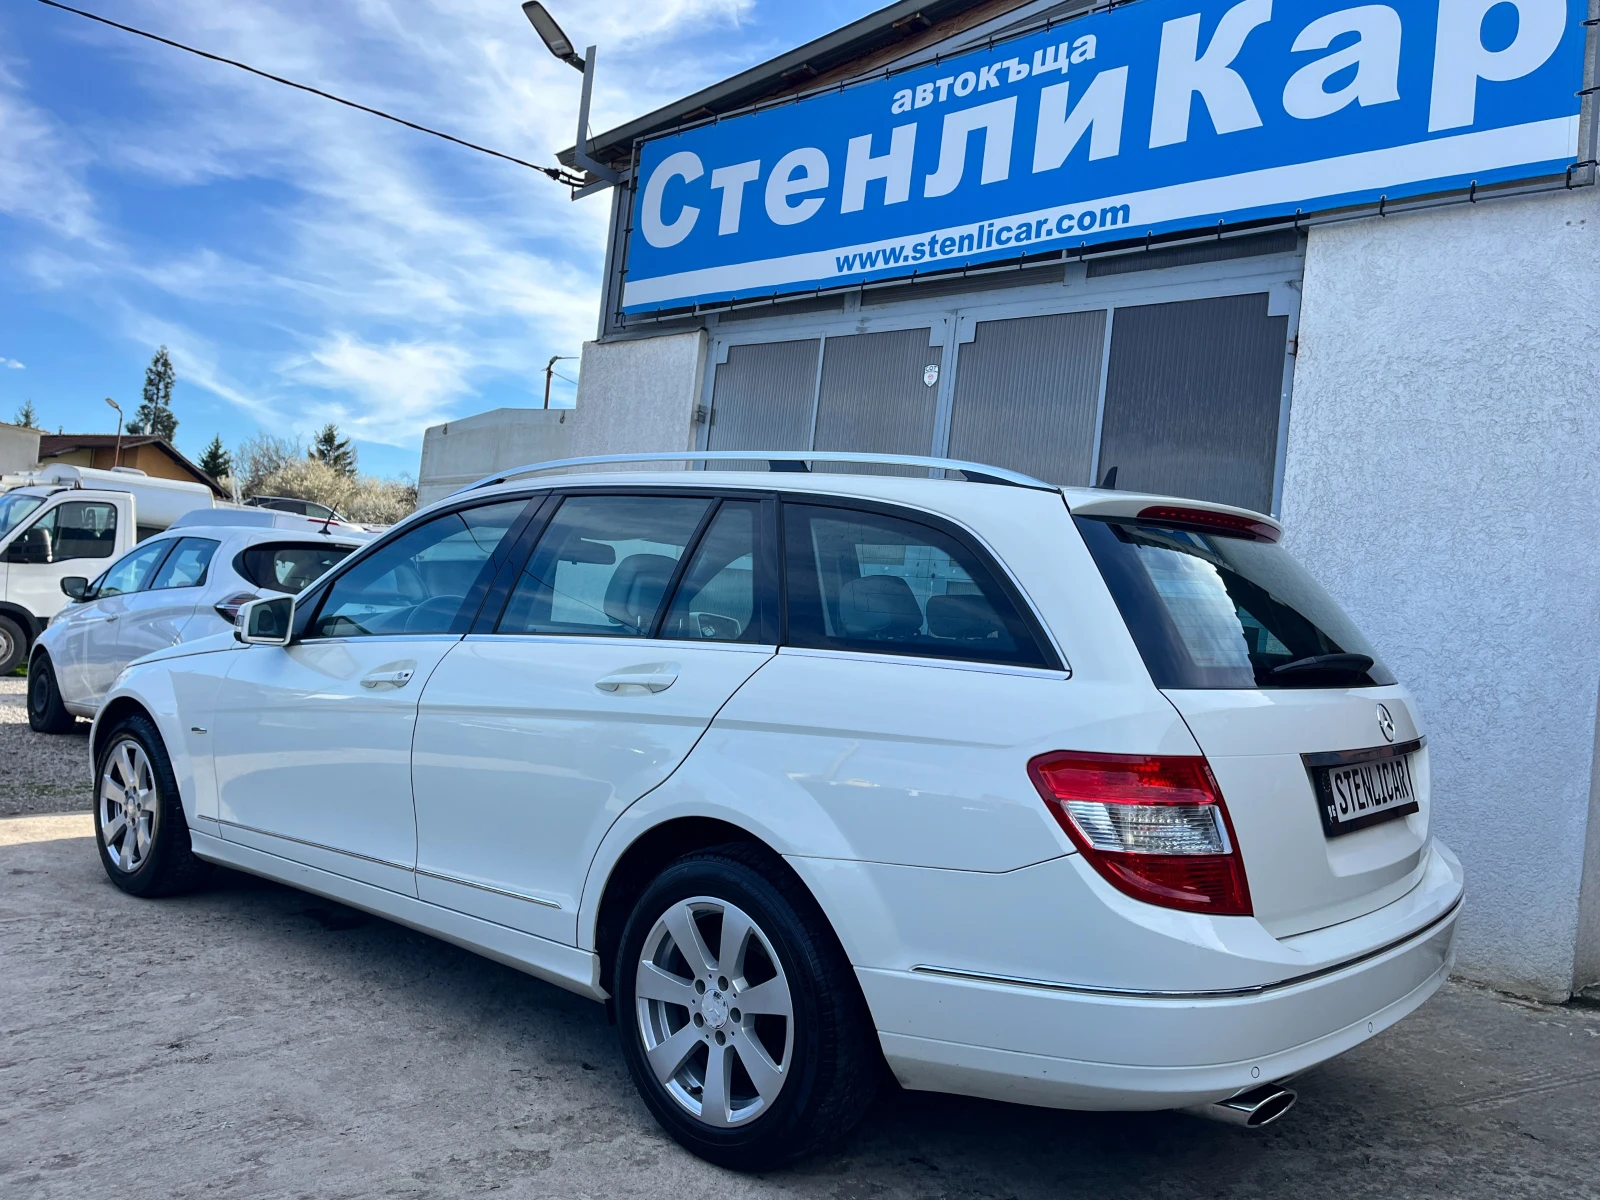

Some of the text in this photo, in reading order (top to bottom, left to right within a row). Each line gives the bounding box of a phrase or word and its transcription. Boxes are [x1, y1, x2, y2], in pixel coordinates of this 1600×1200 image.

[892, 34, 1097, 114] автокъща
[836, 203, 1131, 273] www.stenlicar.com
[1335, 760, 1409, 815] STENLICAR
